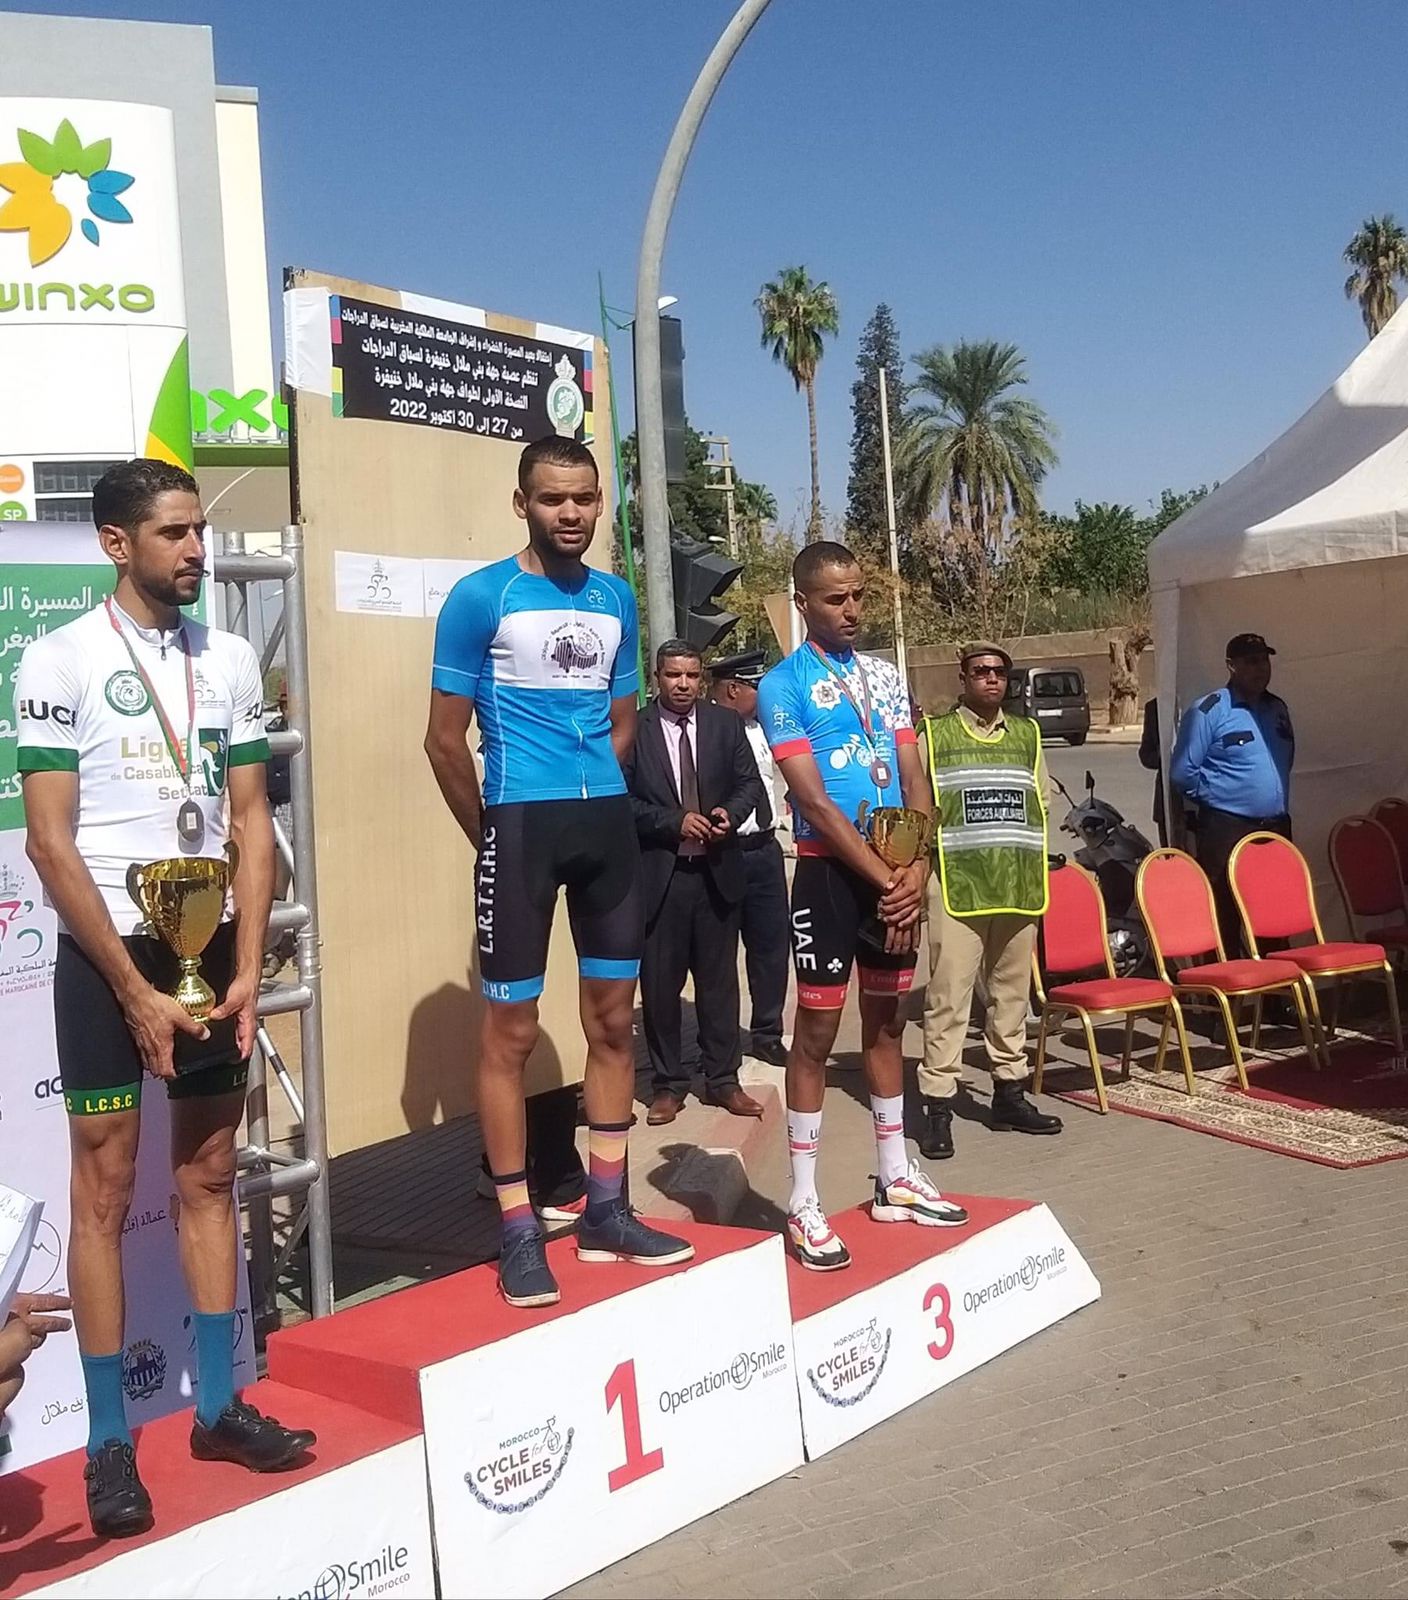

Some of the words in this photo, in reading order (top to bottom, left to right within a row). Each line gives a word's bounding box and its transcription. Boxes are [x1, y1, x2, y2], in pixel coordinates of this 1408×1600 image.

[361, 337, 397, 359] الدراجات
[399, 344, 424, 364] لسباق
[425, 348, 452, 371] خنيفرة
[452, 354, 471, 373] ملال
[472, 360, 485, 380] بني
[485, 361, 500, 381] جهة
[374, 366, 403, 389] خنيفرة
[404, 371, 424, 391] ملال
[425, 377, 438, 398] بني
[439, 378, 456, 399] جهة
[389, 398, 428, 420] 2022
[457, 410, 475, 429] 30
[491, 416, 509, 435] 27
[510, 426, 523, 440] من
[21, 586, 92, 619] المسيرة
[792, 908, 817, 972] UAE
[85, 1094, 133, 1113] L.C.S.C
[963, 1271, 1021, 1313] Operation
[1035, 1246, 1065, 1275] Smile
[922, 1282, 955, 1360] 3
[817, 1346, 859, 1378] CYCLE
[832, 1355, 876, 1391] SMILES
[659, 1369, 731, 1414] Operation
[750, 1342, 785, 1373] Smile
[604, 1358, 664, 1493] 1
[499, 1427, 540, 1450] MOROCCO
[477, 1447, 530, 1483] CYCLE
[493, 1458, 552, 1496] SMILES
[348, 1545, 408, 1590] Smile
[367, 1573, 411, 1598] Morocco
